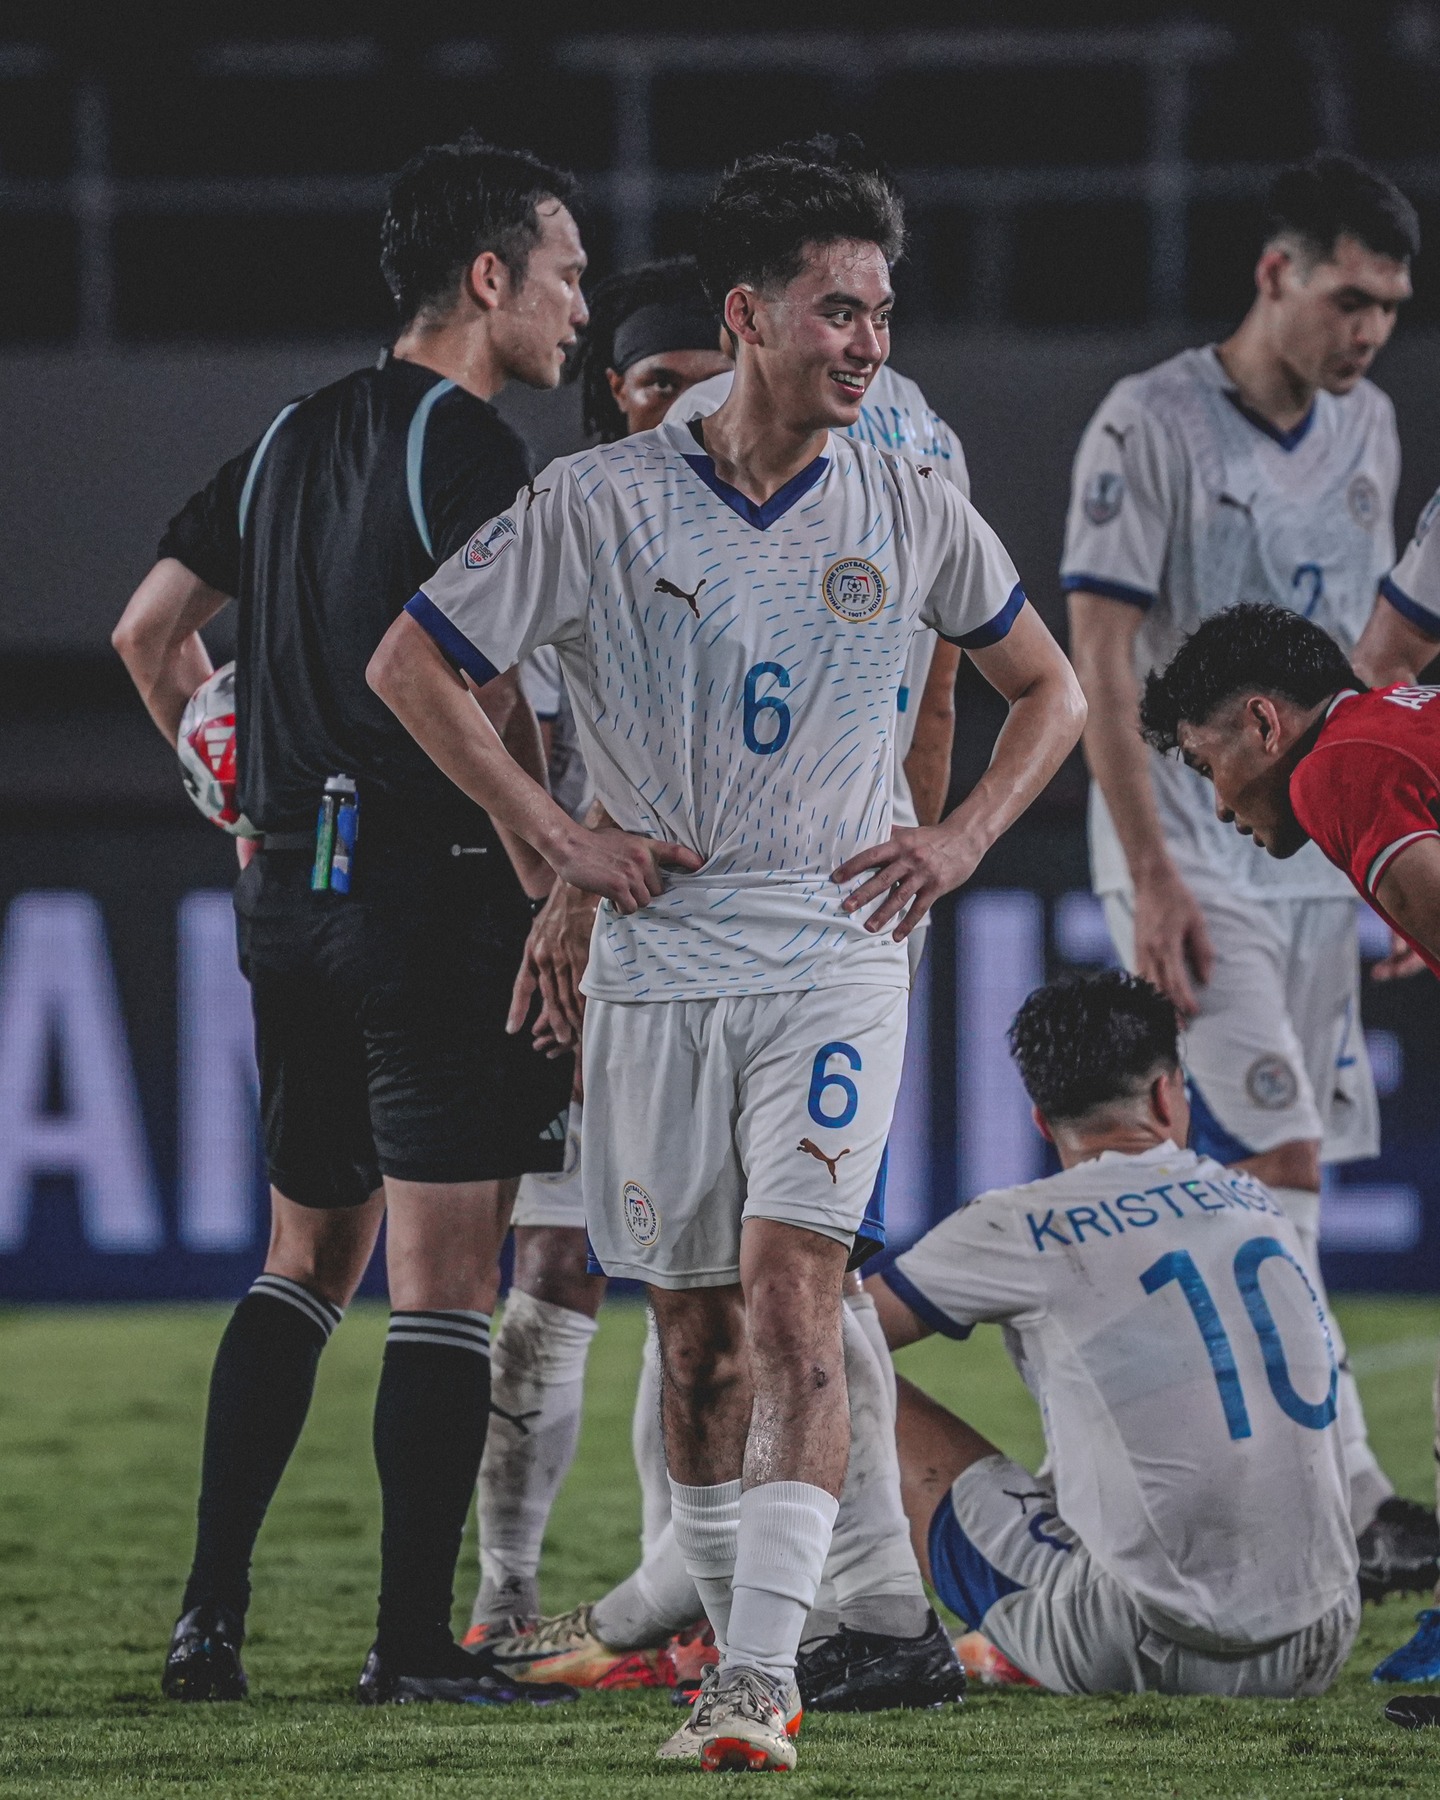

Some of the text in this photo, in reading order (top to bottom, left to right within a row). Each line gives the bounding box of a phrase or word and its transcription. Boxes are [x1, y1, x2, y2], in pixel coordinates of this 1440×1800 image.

[470, 551, 482, 562] CUP
[826, 561, 882, 612] PHILIPPINE FOOTBALL FEDERATION
[842, 593, 870, 604] PFF
[743, 661, 791, 755] 6
[807, 1041, 862, 1129] 6
[1139, 1236, 1339, 1440] 10
